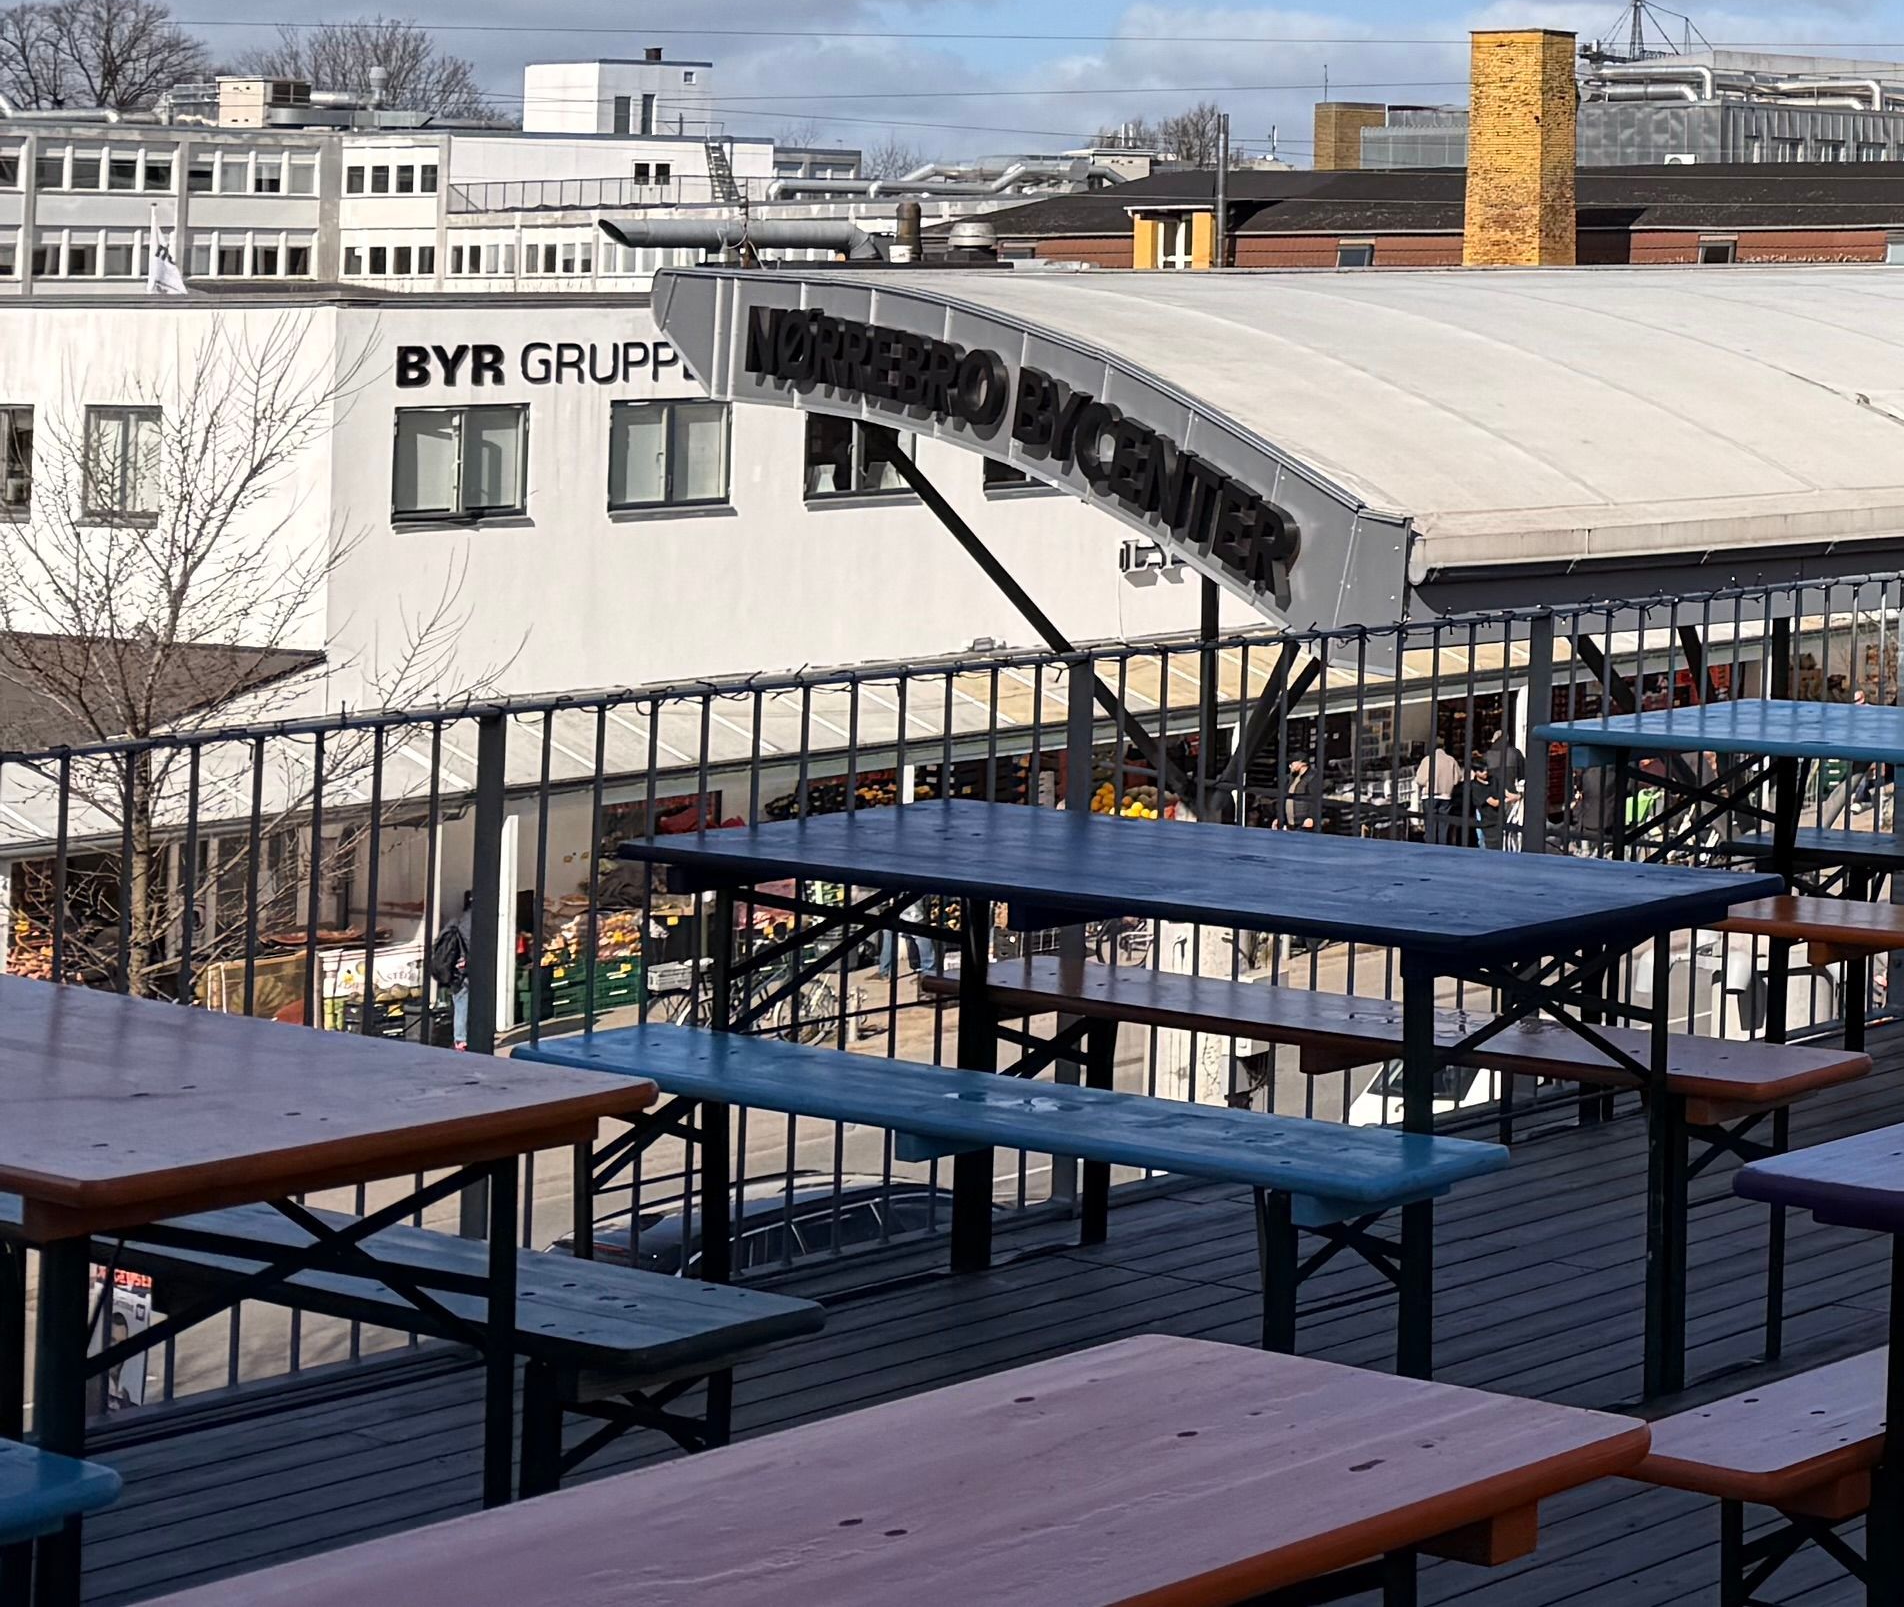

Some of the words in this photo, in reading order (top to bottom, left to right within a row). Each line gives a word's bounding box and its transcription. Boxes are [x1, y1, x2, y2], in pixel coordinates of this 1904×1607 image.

[395, 344, 506, 388] BYR
[745, 305, 1008, 425] NØRREBRO
[1011, 366, 1302, 611] BYCENTER
